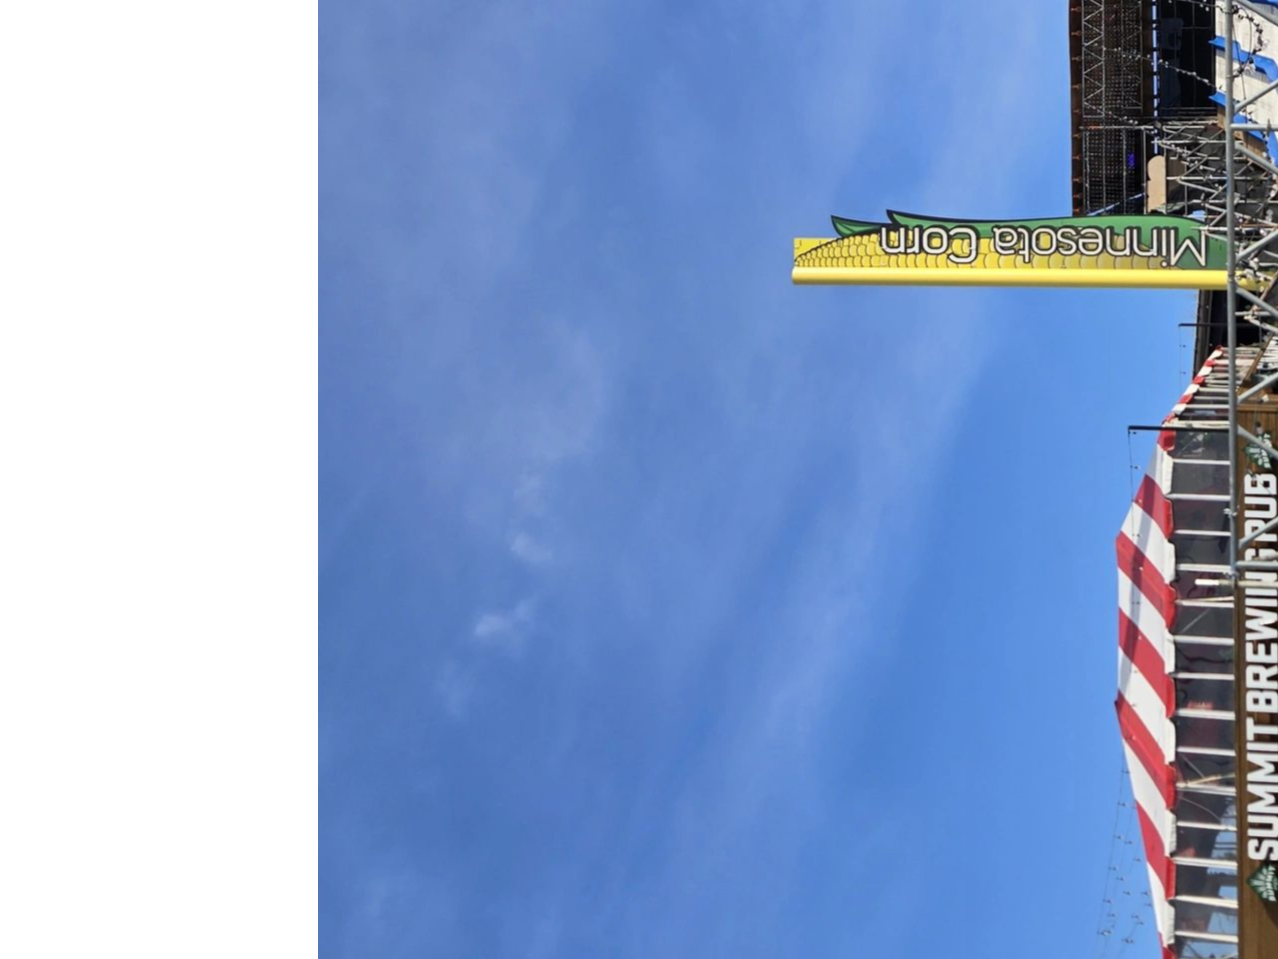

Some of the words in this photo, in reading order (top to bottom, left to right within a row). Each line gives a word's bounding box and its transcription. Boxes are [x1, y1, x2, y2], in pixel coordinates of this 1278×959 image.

[878, 225, 979, 265] Corn
[991, 224, 1207, 269] Minnesota
[1244, 472, 1278, 542] PUB
[1265, 864, 1277, 902] SUMMIT
